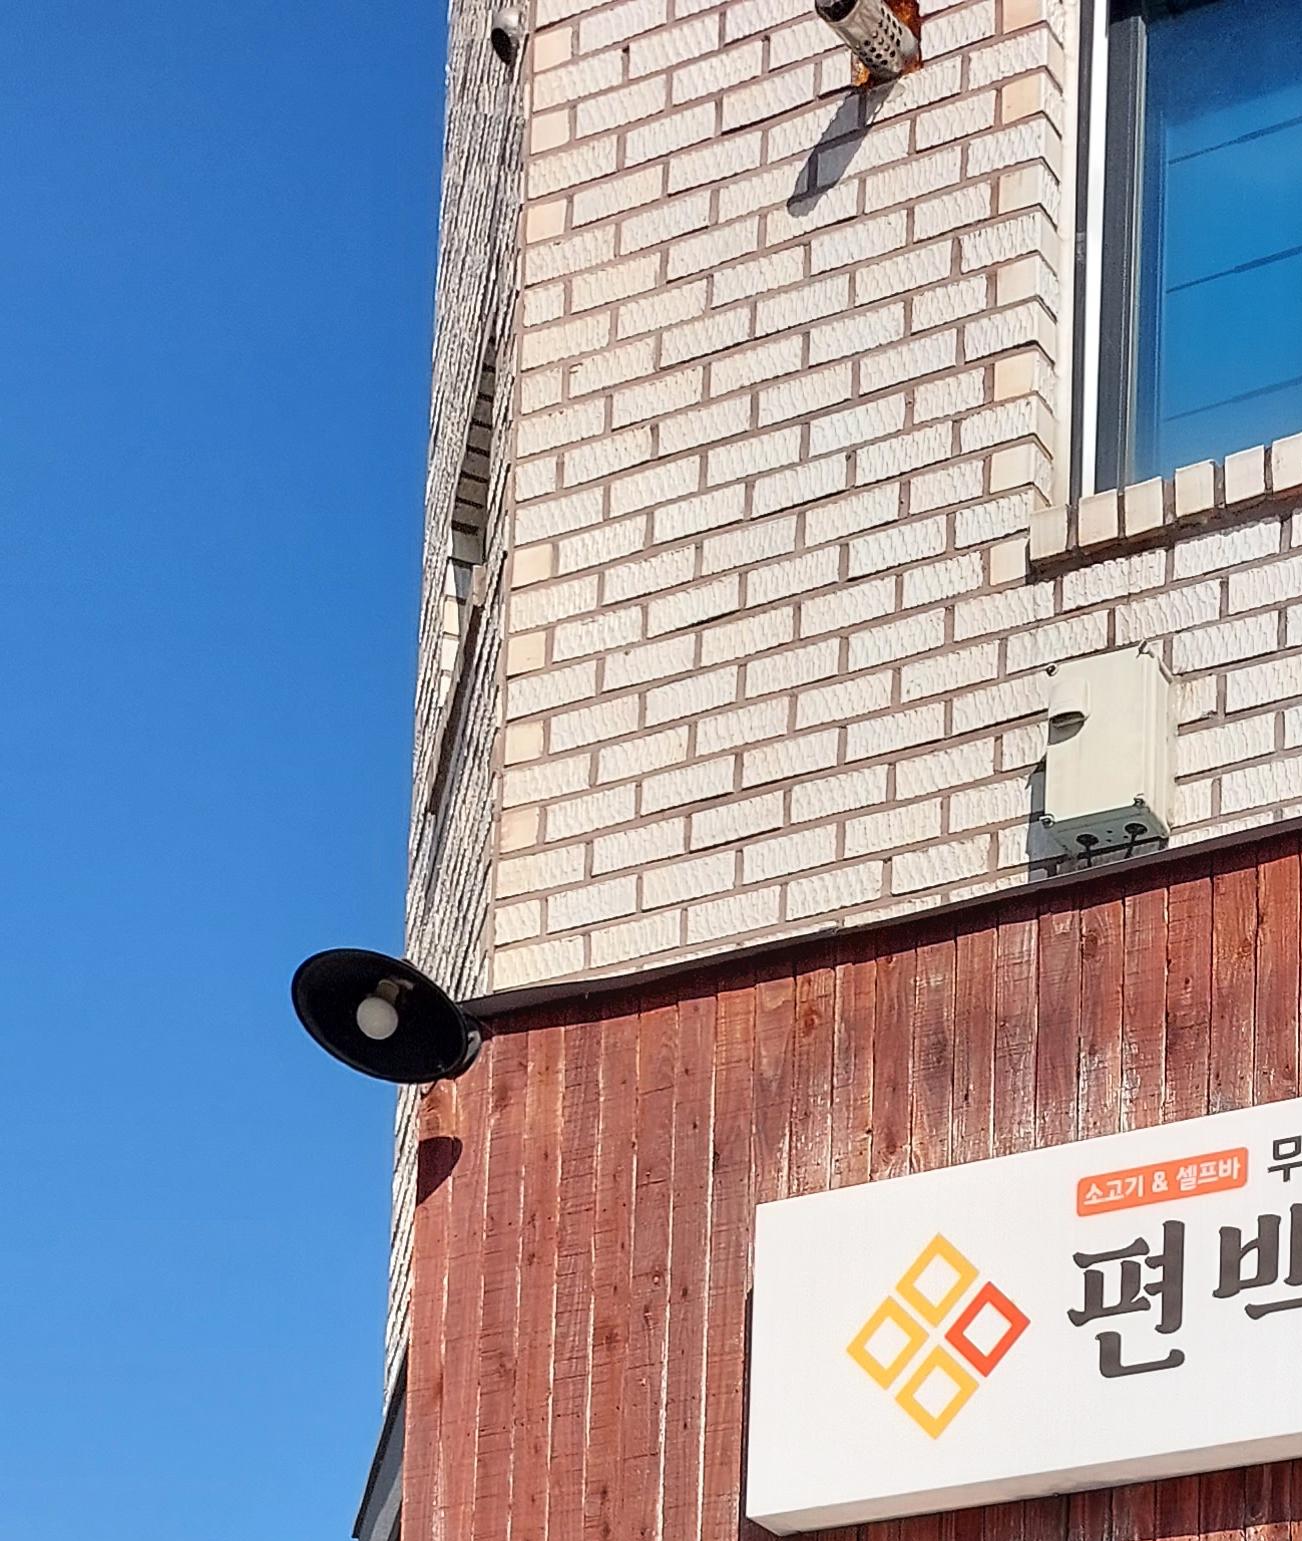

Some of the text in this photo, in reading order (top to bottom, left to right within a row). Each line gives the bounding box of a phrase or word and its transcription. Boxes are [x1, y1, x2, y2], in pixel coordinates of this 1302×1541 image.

[1082, 1157, 1242, 1206] 소고기 & 셀프바
